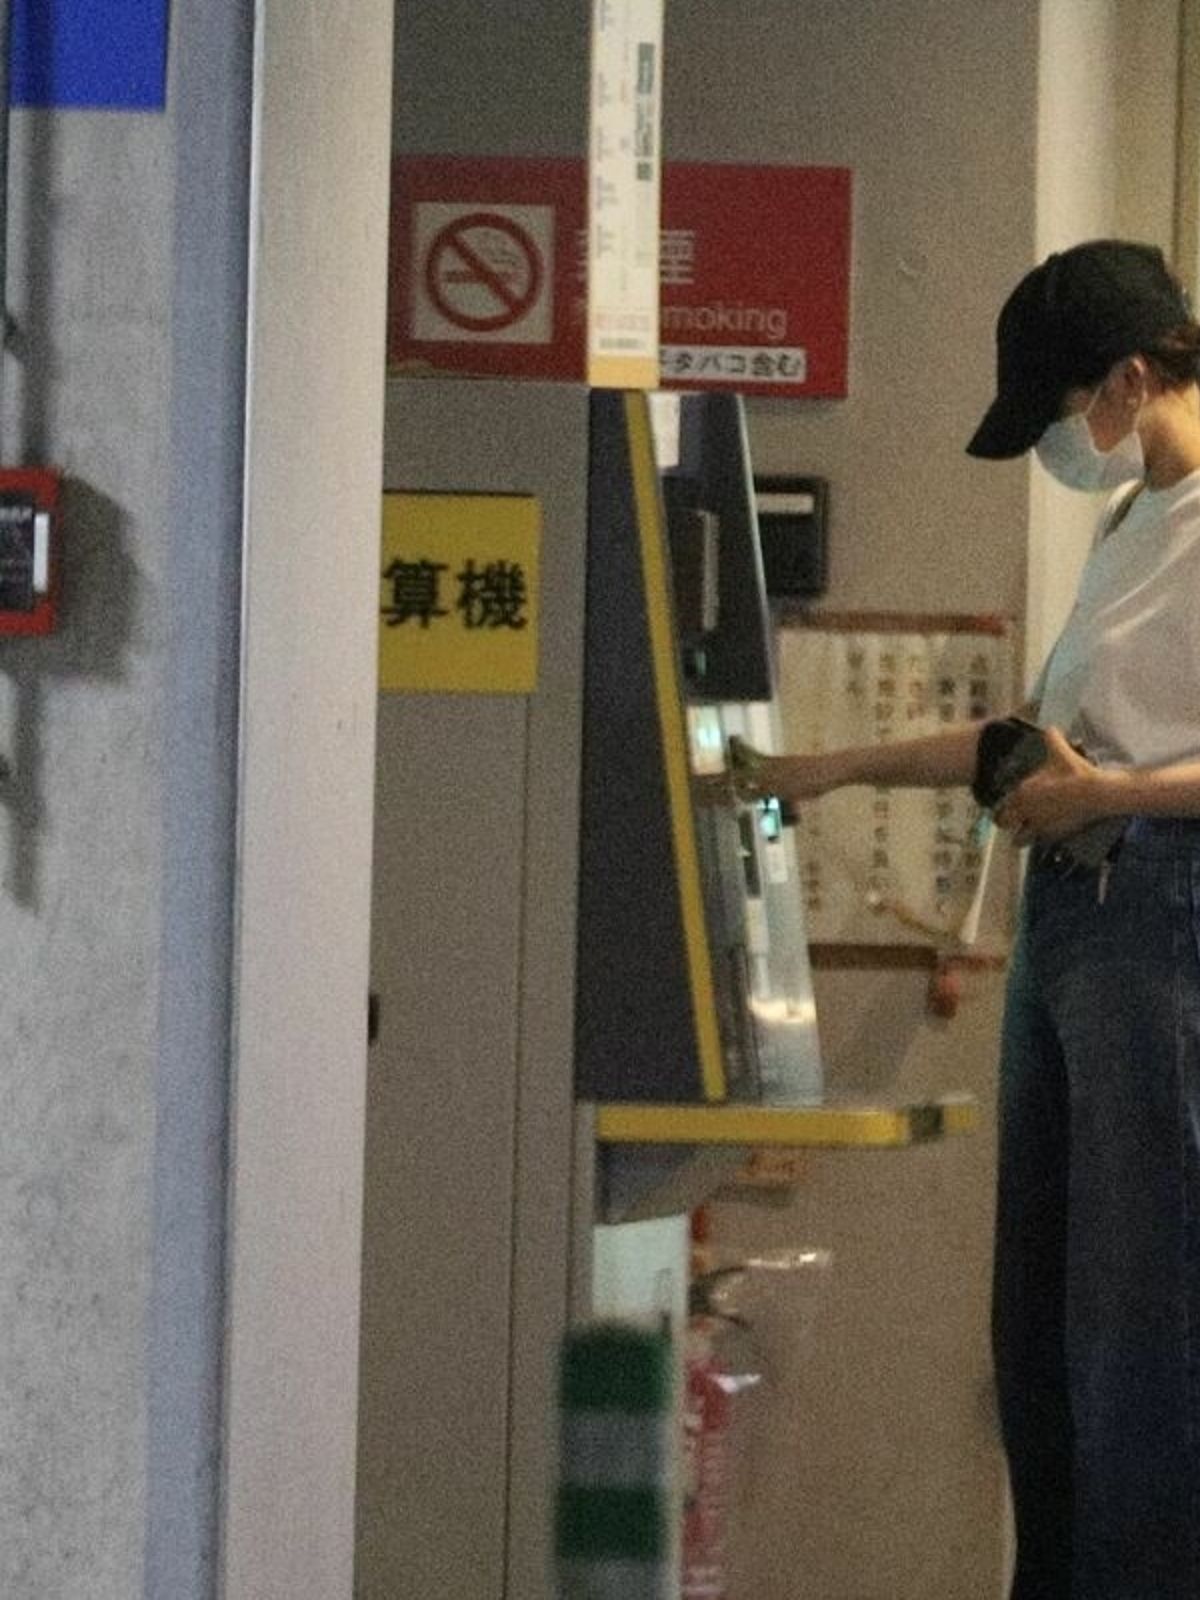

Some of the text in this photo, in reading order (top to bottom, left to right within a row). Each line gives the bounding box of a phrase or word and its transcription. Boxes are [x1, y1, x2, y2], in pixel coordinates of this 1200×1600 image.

[661, 301, 789, 340] moking
[661, 352, 802, 377] タバコ含む
[380, 558, 528, 631] 算機
